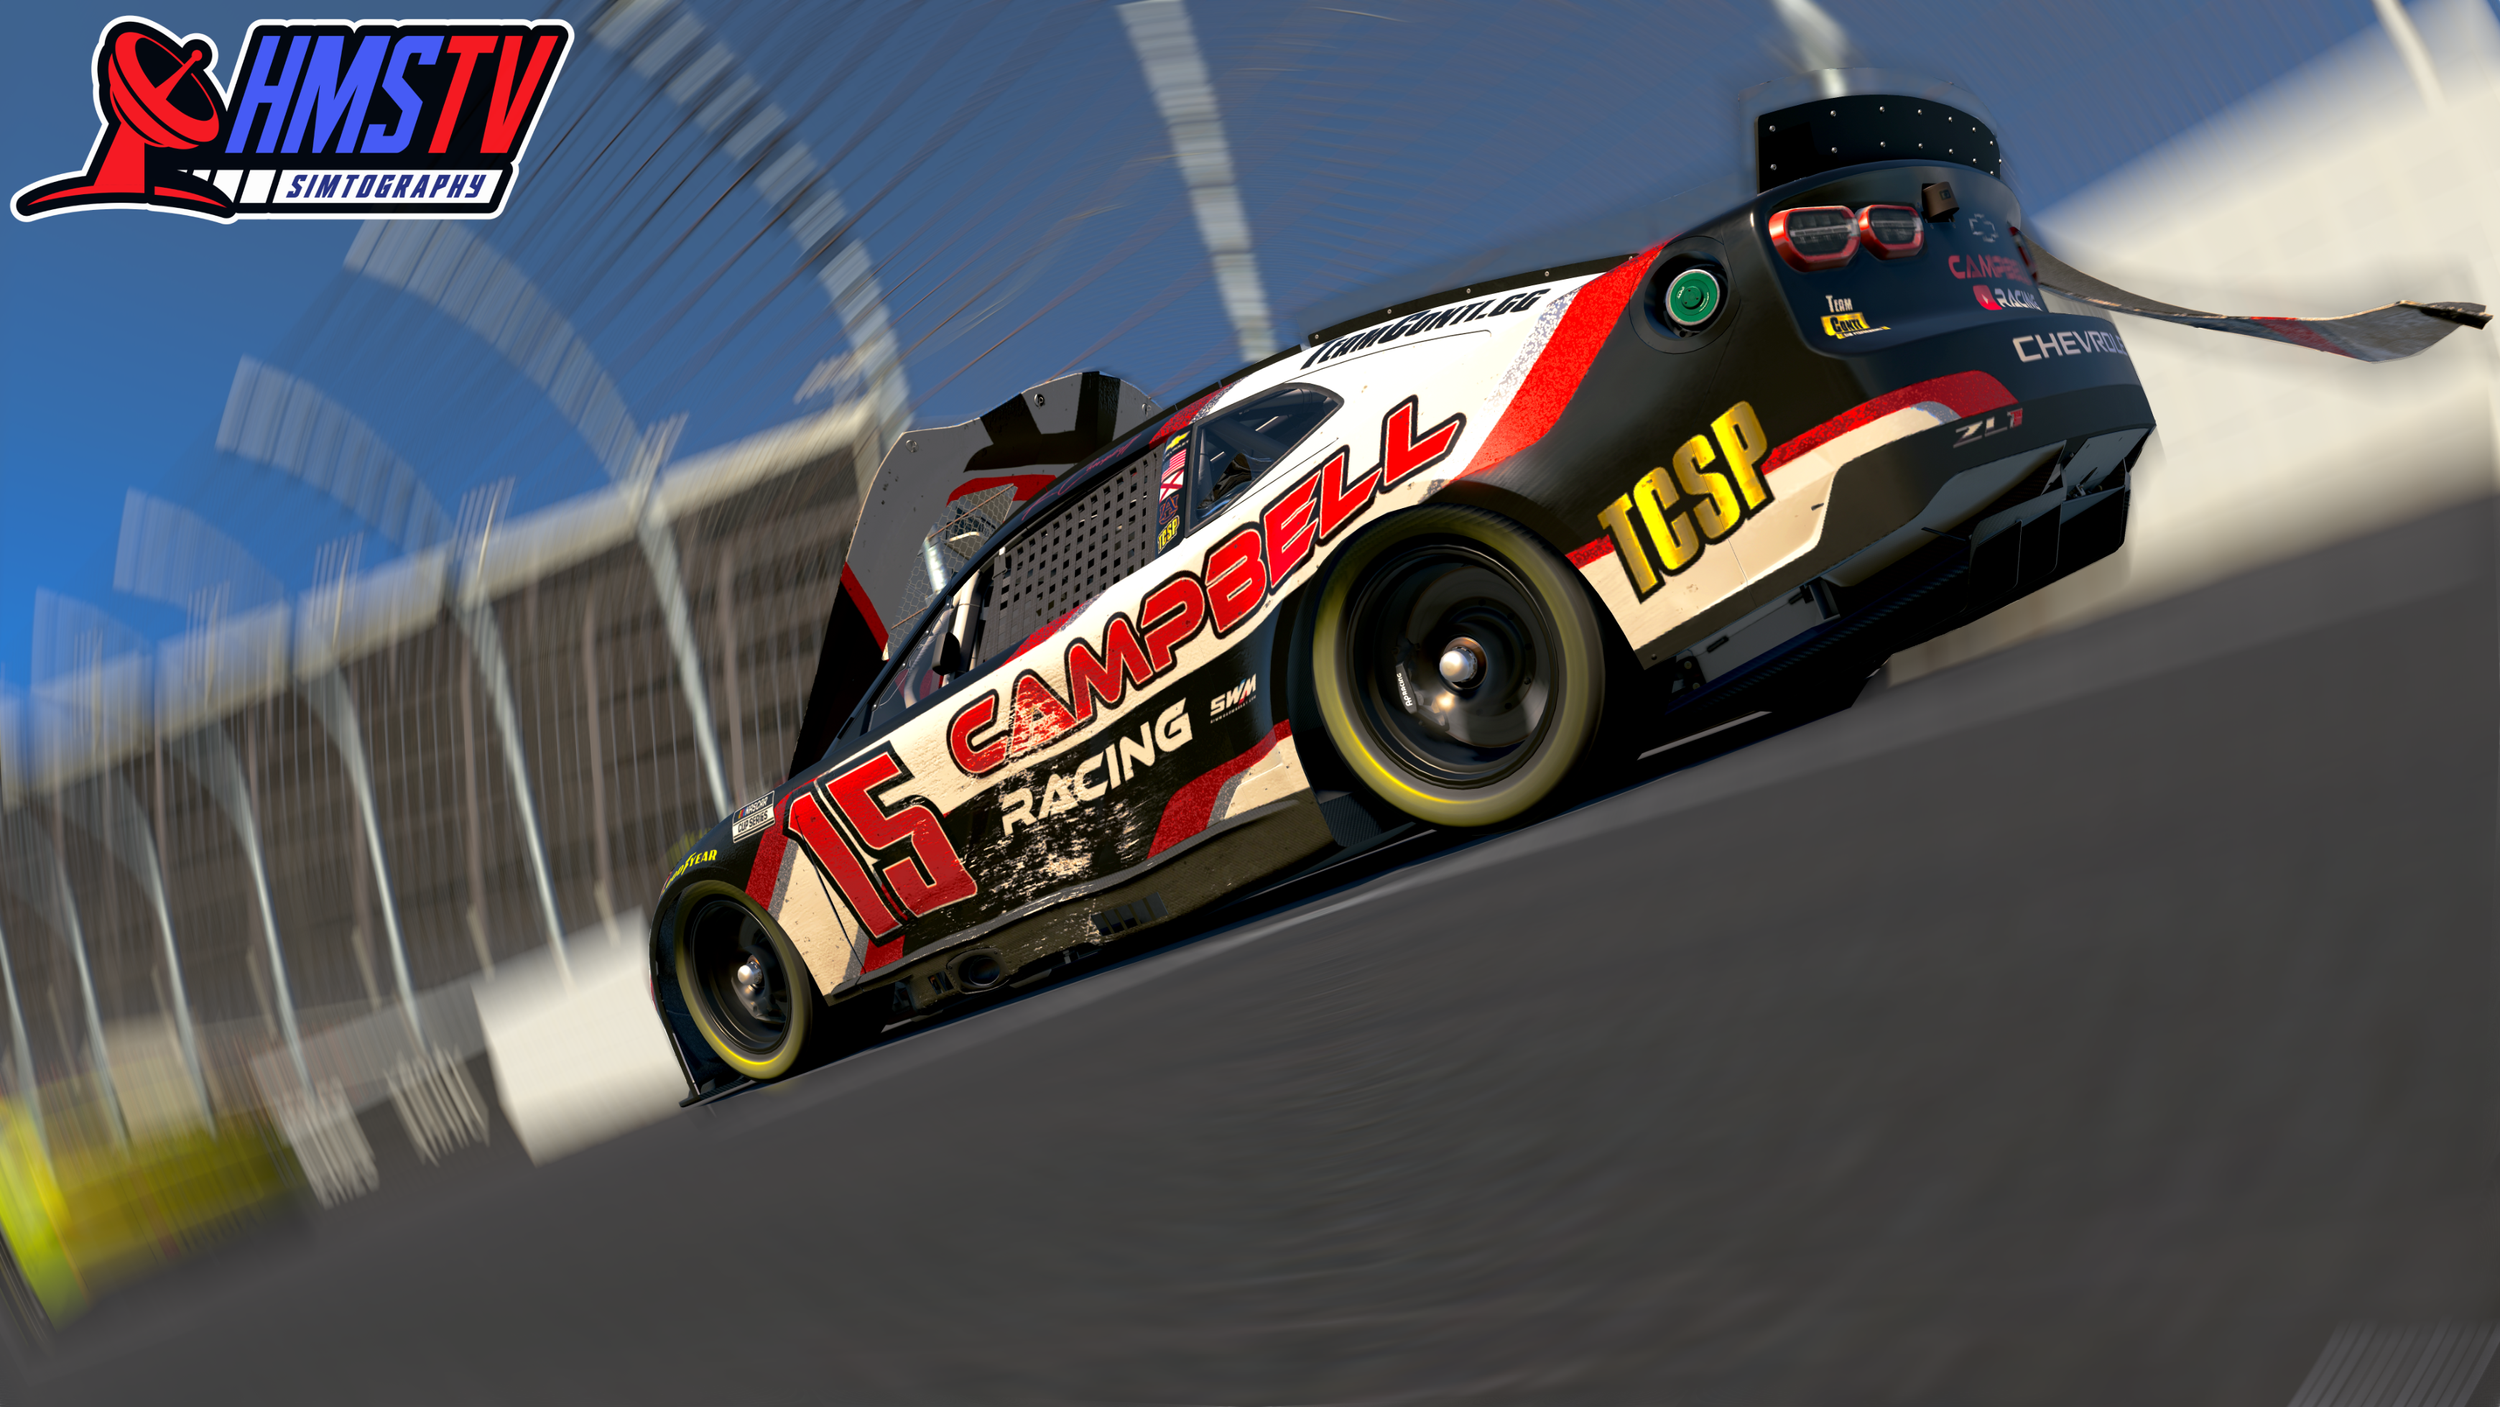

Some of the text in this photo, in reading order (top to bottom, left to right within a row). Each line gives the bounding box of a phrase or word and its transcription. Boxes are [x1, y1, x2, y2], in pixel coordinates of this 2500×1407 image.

[2012, 330, 2128, 363] CHEVROLE
[1953, 408, 2023, 449] ZL1
[1597, 400, 1769, 597] TCSP
[947, 394, 1466, 777] CAMPBELL
[1210, 673, 1257, 717] SWM
[1001, 697, 1193, 836] RACING
[738, 811, 768, 833] CUP SERIES
[786, 750, 979, 942] 15
